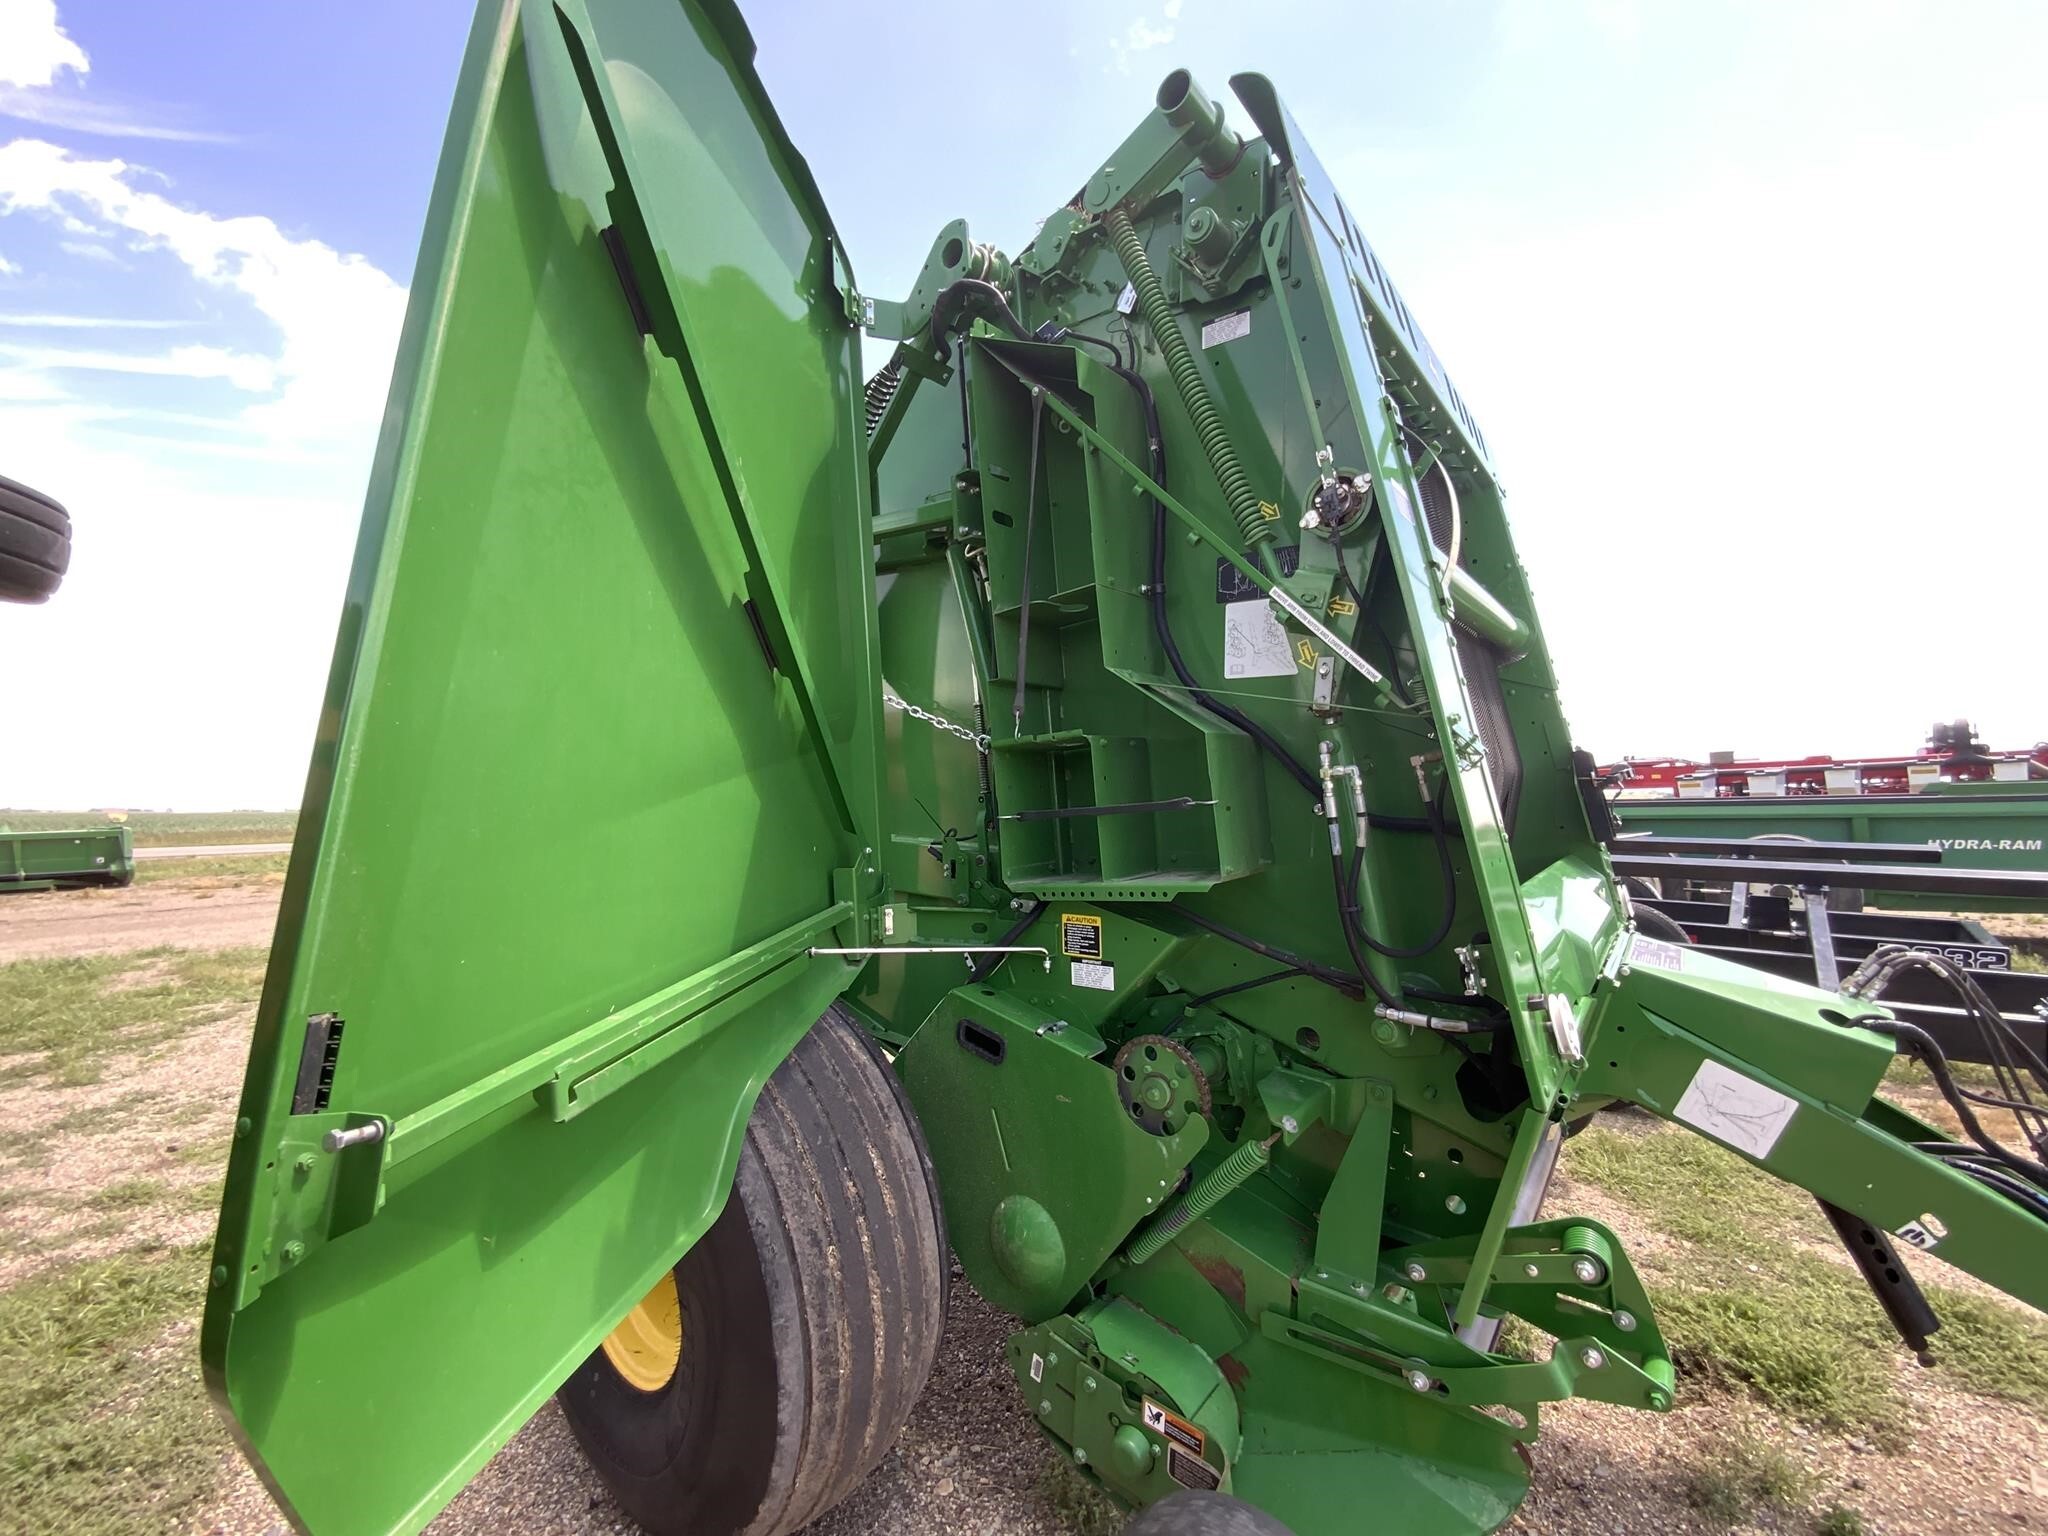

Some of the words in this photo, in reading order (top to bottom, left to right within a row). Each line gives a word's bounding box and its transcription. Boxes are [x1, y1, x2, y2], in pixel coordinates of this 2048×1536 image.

[1295, 608, 1308, 622] FROM
[1307, 618, 1321, 632] NOTCH
[1327, 636, 1344, 652] LOWER
[1348, 653, 1366, 671] THREAD
[1927, 838, 2042, 850] HYDRA-RAM
[1071, 916, 1098, 924] CAUTION
